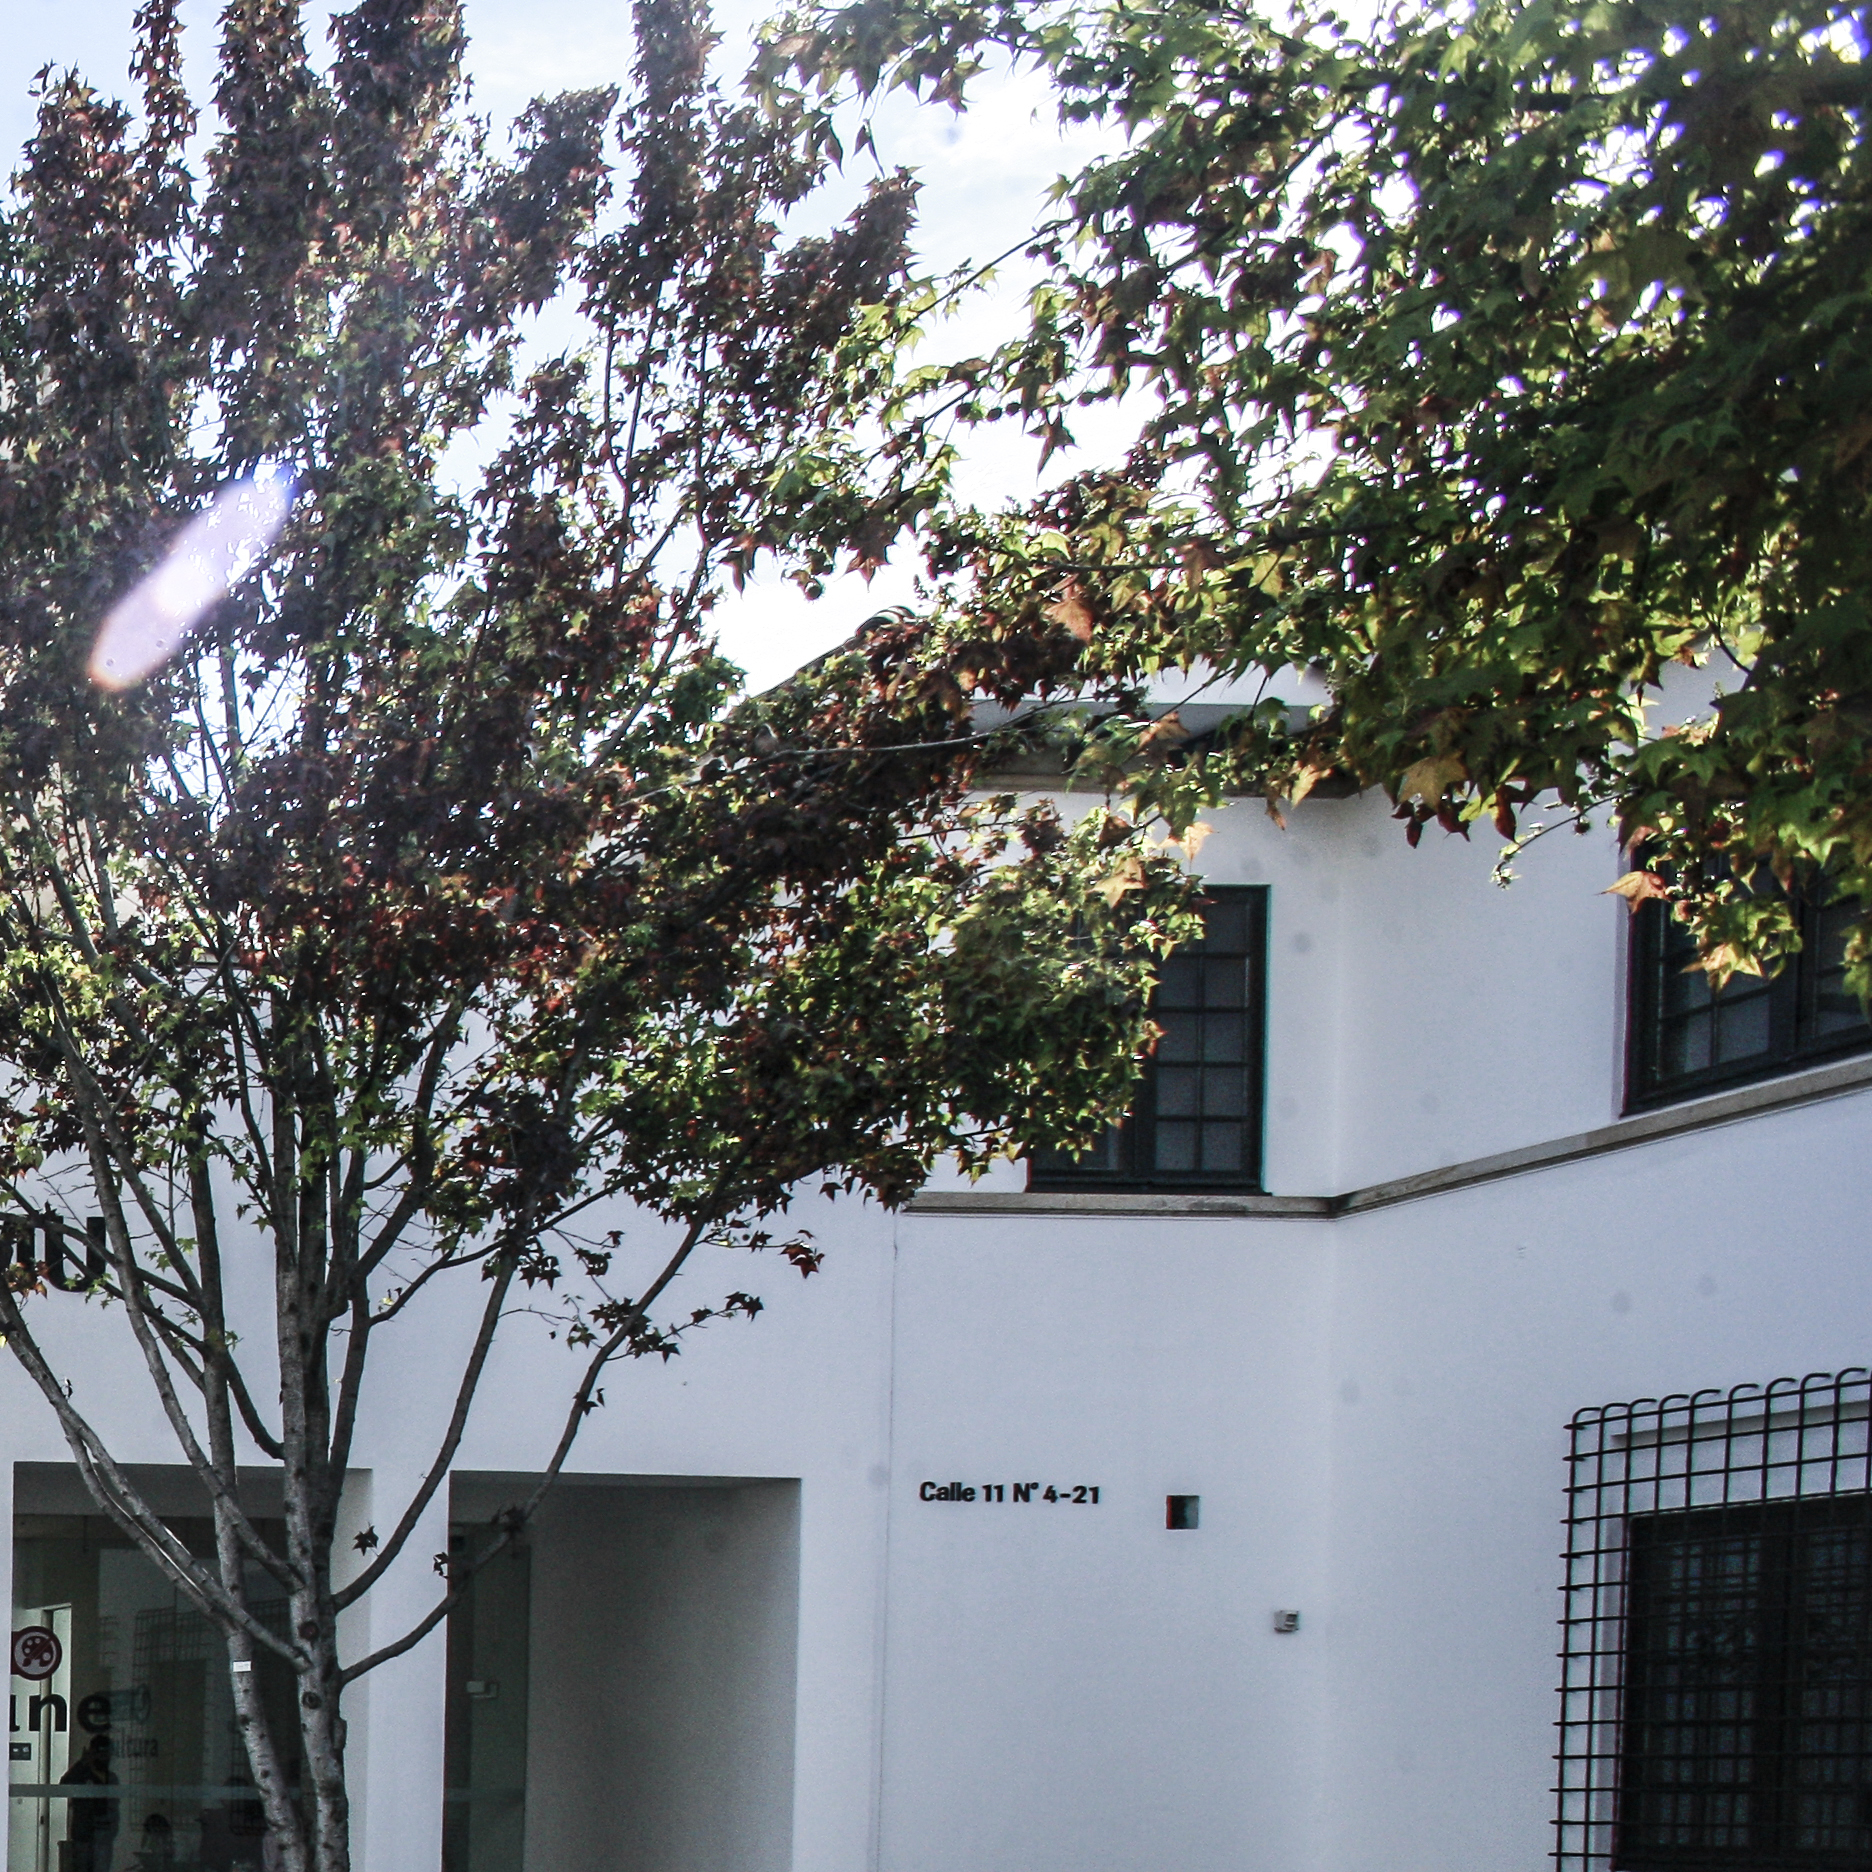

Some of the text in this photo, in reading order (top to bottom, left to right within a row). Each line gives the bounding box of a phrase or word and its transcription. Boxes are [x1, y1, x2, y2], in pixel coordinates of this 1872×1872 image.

[919, 1481, 975, 1502] Calle
[982, 1484, 1004, 1502] 11
[1042, 1485, 1100, 1504] 4-21
